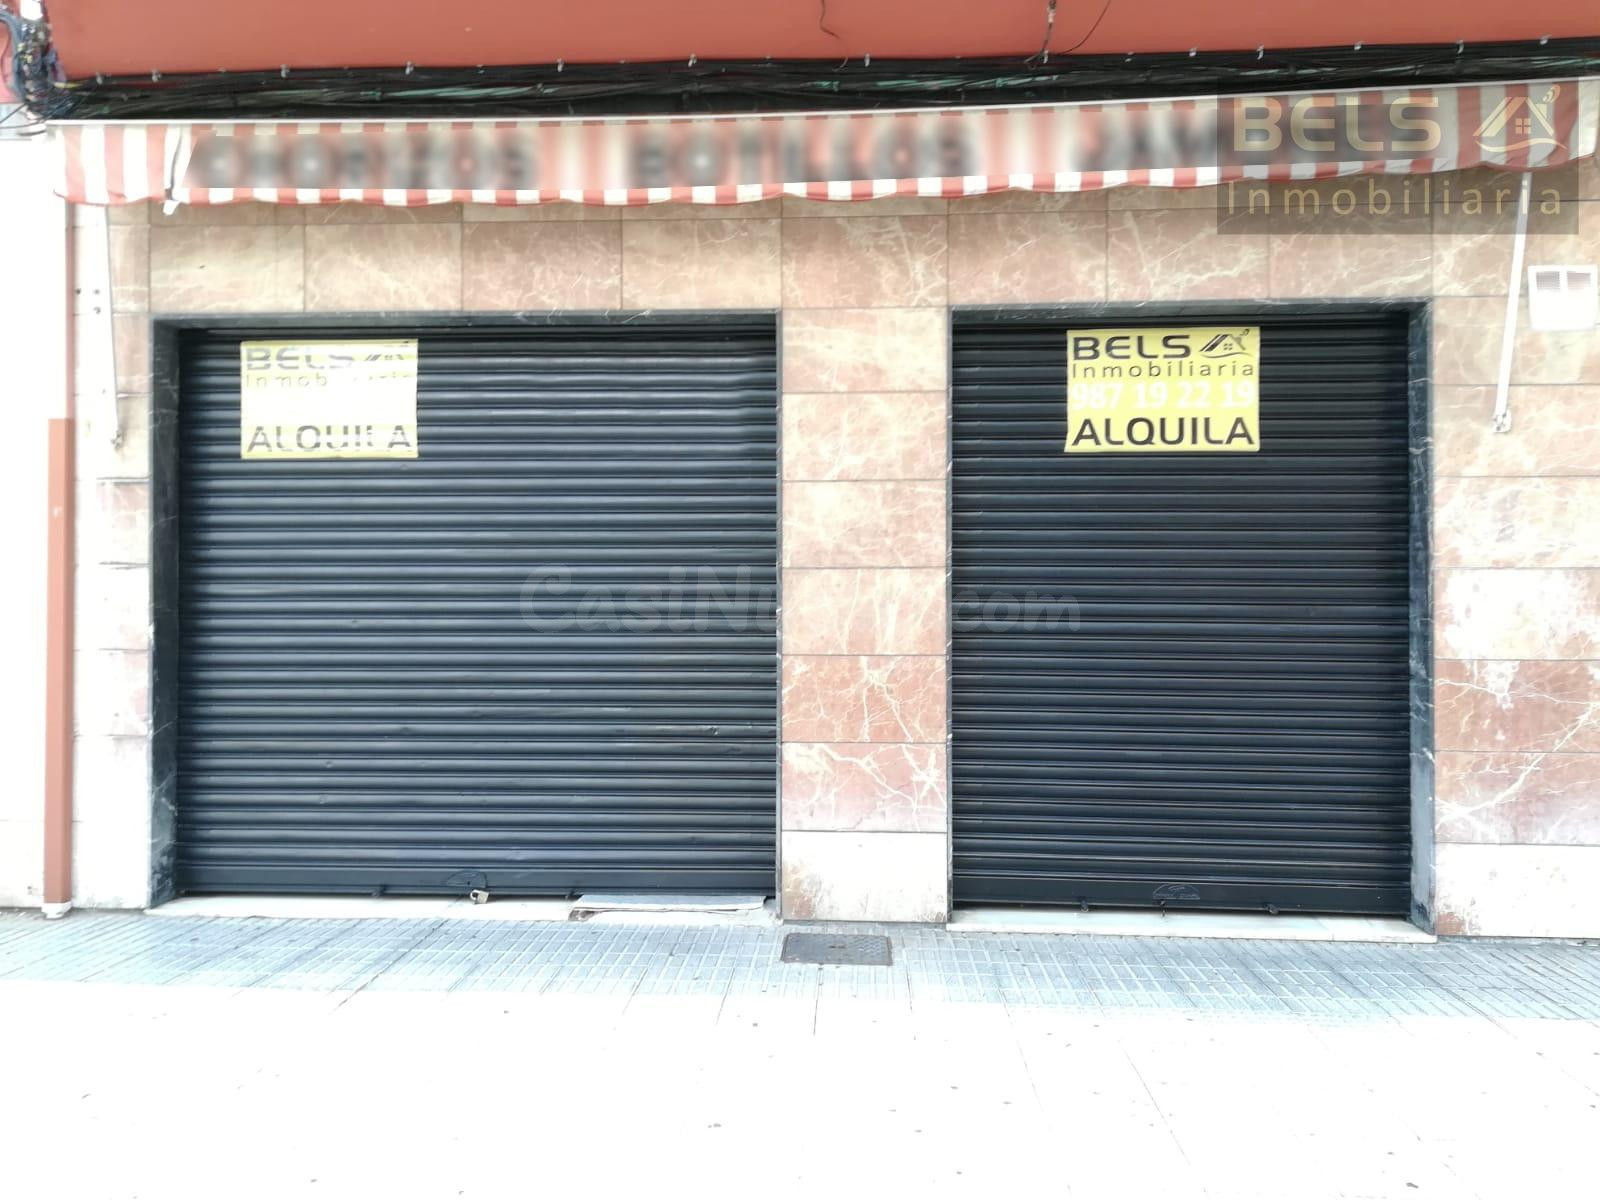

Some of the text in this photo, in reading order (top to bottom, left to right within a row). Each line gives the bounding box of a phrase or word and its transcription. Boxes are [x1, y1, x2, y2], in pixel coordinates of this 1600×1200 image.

[1073, 335, 1191, 361] BELS
[1072, 360, 1254, 378] Inmobiliaria
[1071, 378, 1255, 411] 987 19 22 19
[1072, 417, 1255, 446] ALQUILA
